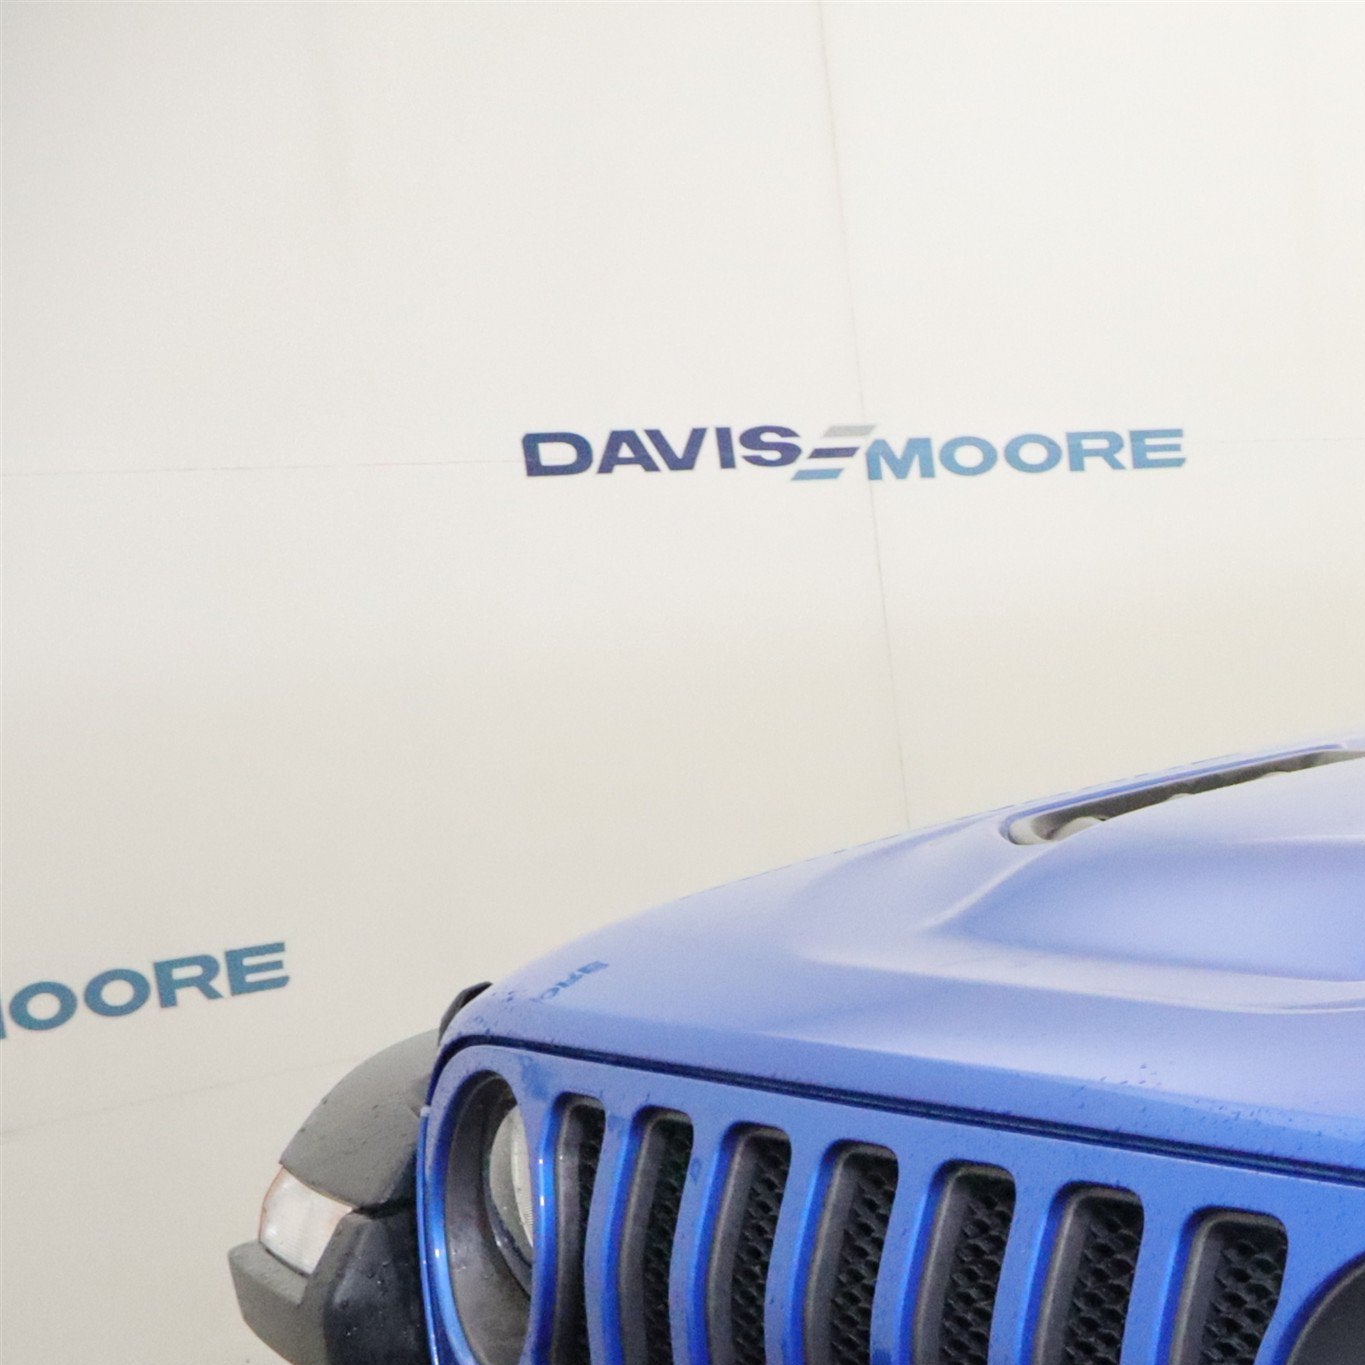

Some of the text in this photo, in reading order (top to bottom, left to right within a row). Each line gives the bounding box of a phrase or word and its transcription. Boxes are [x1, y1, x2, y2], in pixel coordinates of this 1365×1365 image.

[521, 425, 1187, 482] DAVIS MOORE
[0, 941, 291, 1040] OORE
